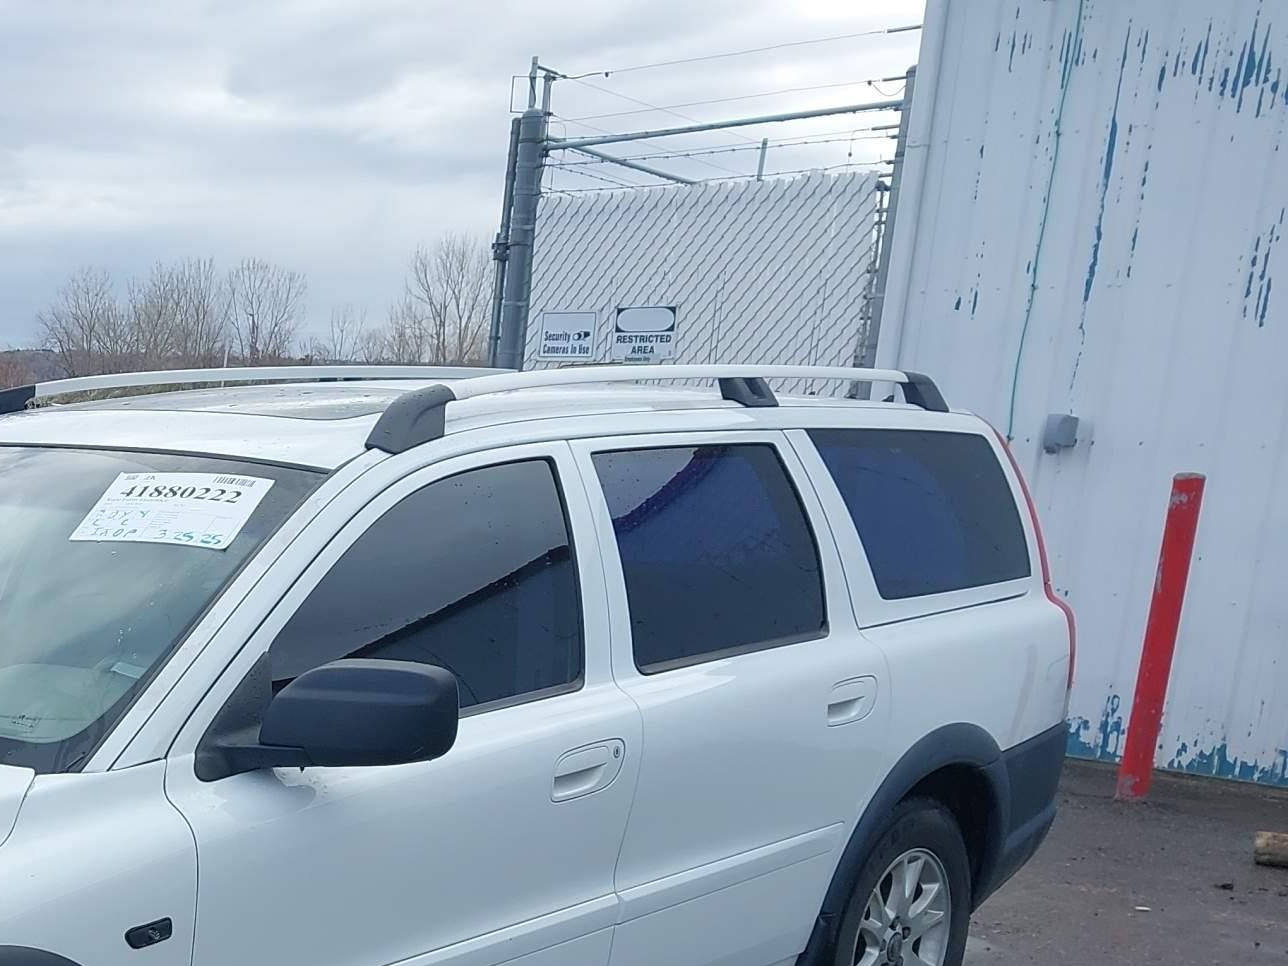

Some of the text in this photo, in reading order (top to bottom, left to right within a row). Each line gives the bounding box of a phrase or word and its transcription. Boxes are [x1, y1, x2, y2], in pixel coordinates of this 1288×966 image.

[544, 330, 570, 343] Security
[616, 334, 672, 344] RESTRICTED
[543, 344, 569, 354] Cameras
[578, 344, 590, 354] Use
[631, 345, 655, 354] AREA
[120, 485, 243, 504] 41880222
